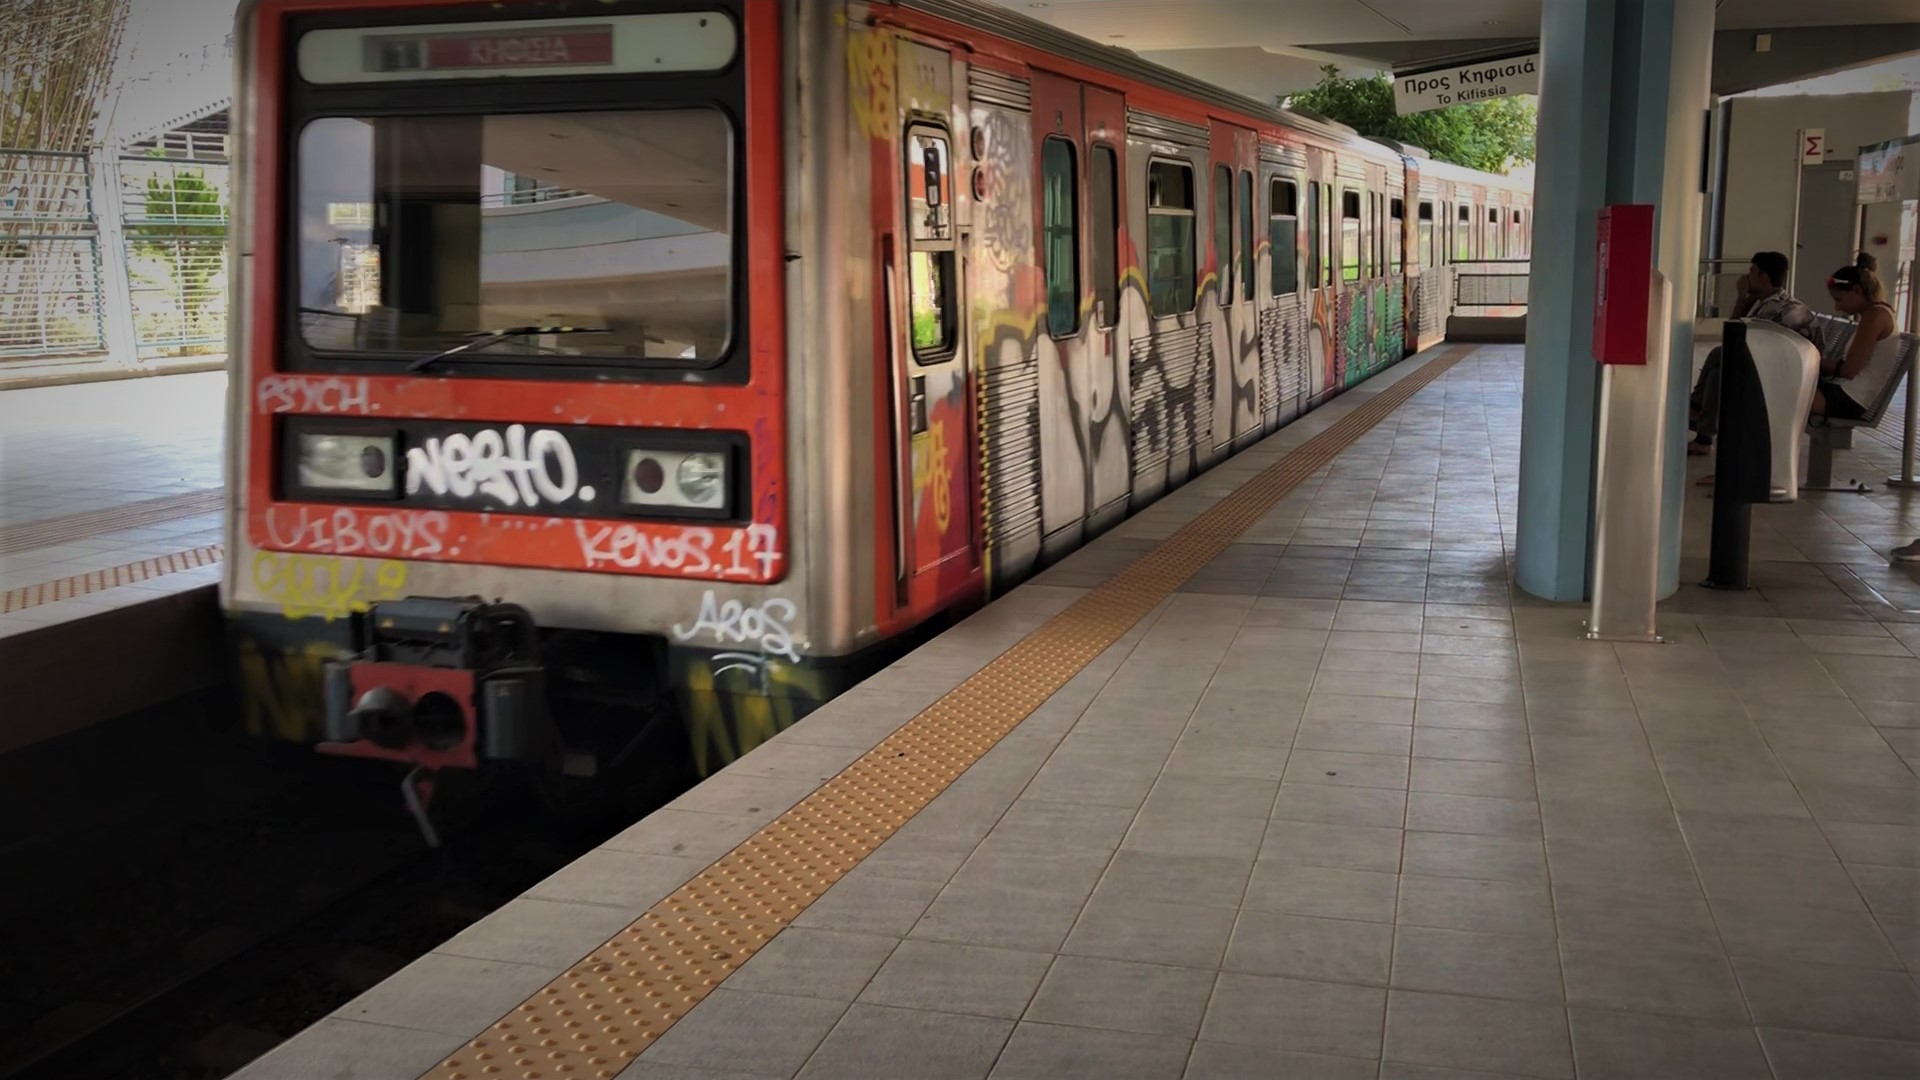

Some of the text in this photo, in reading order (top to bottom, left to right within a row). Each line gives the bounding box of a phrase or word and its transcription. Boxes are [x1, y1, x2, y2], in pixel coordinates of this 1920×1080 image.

[1404, 59, 1536, 95] Προς Κηφισιά
[1436, 85, 1507, 105] To Kifissia
[1805, 136, 1822, 156] Σ
